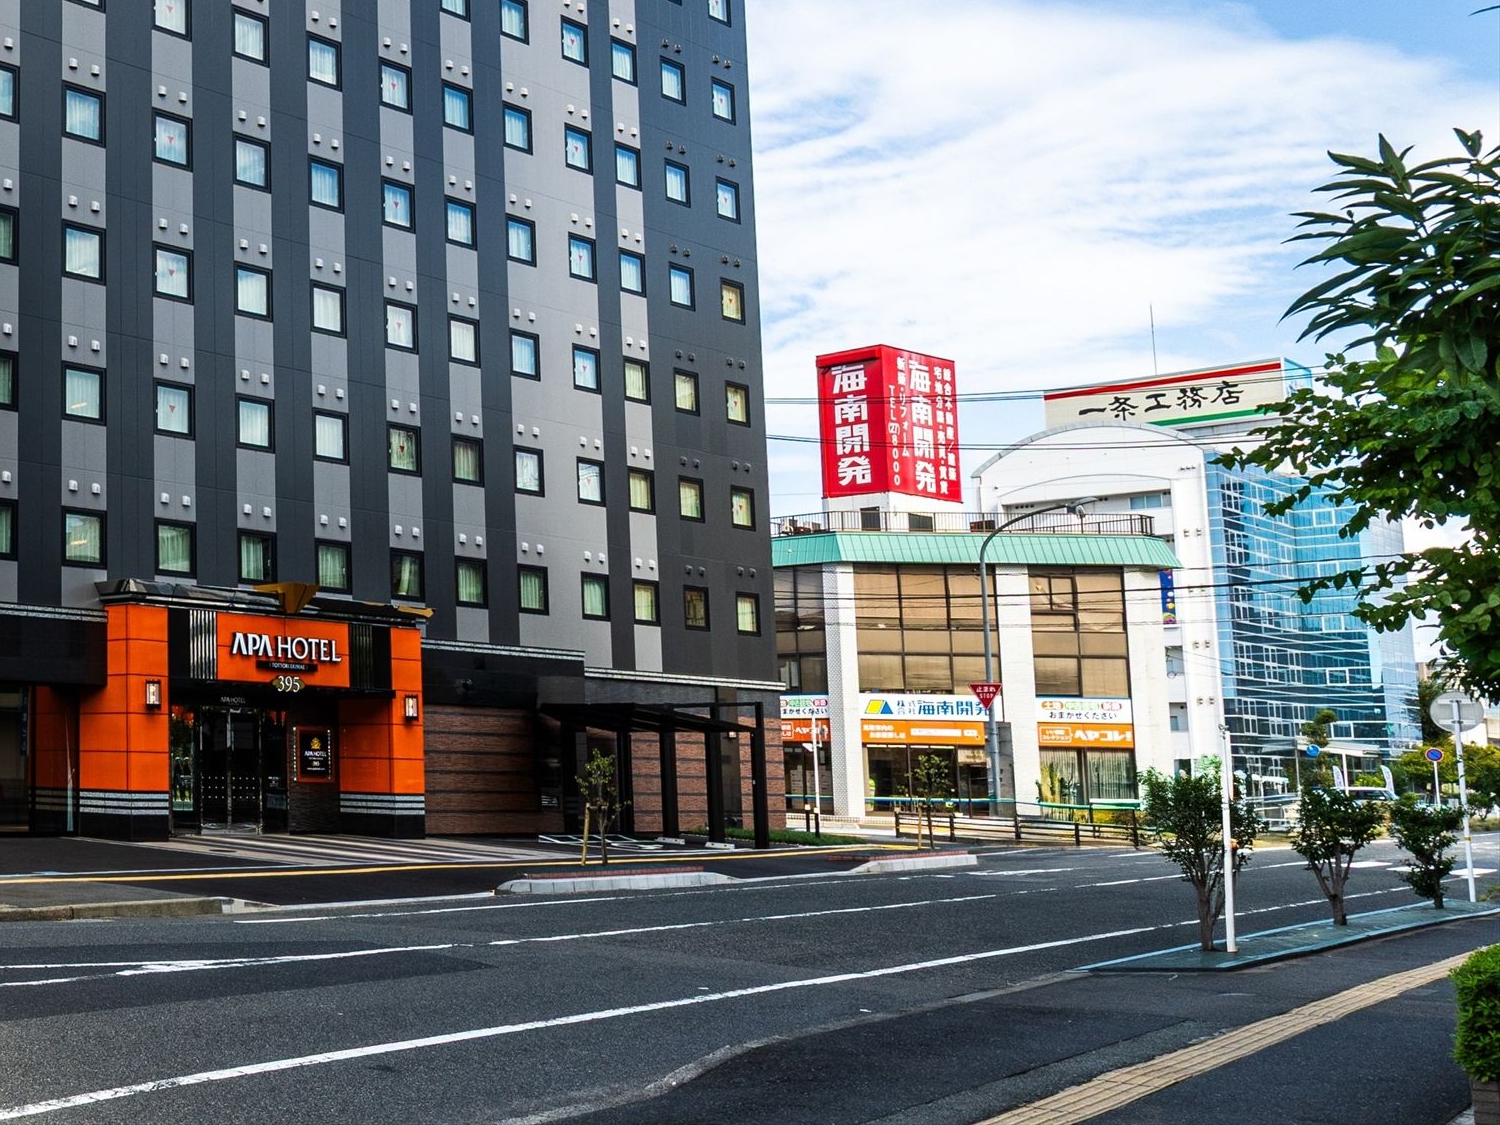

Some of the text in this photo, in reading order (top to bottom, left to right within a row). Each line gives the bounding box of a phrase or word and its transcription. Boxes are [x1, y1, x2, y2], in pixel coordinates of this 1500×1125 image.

[1078, 380, 1245, 421] 一条工務店
[831, 363, 872, 487] 海南開発
[908, 359, 937, 493] 海南開発
[232, 632, 342, 662] APA HOTEL
[277, 675, 300, 693] 395
[976, 685, 996, 693] 止まれ
